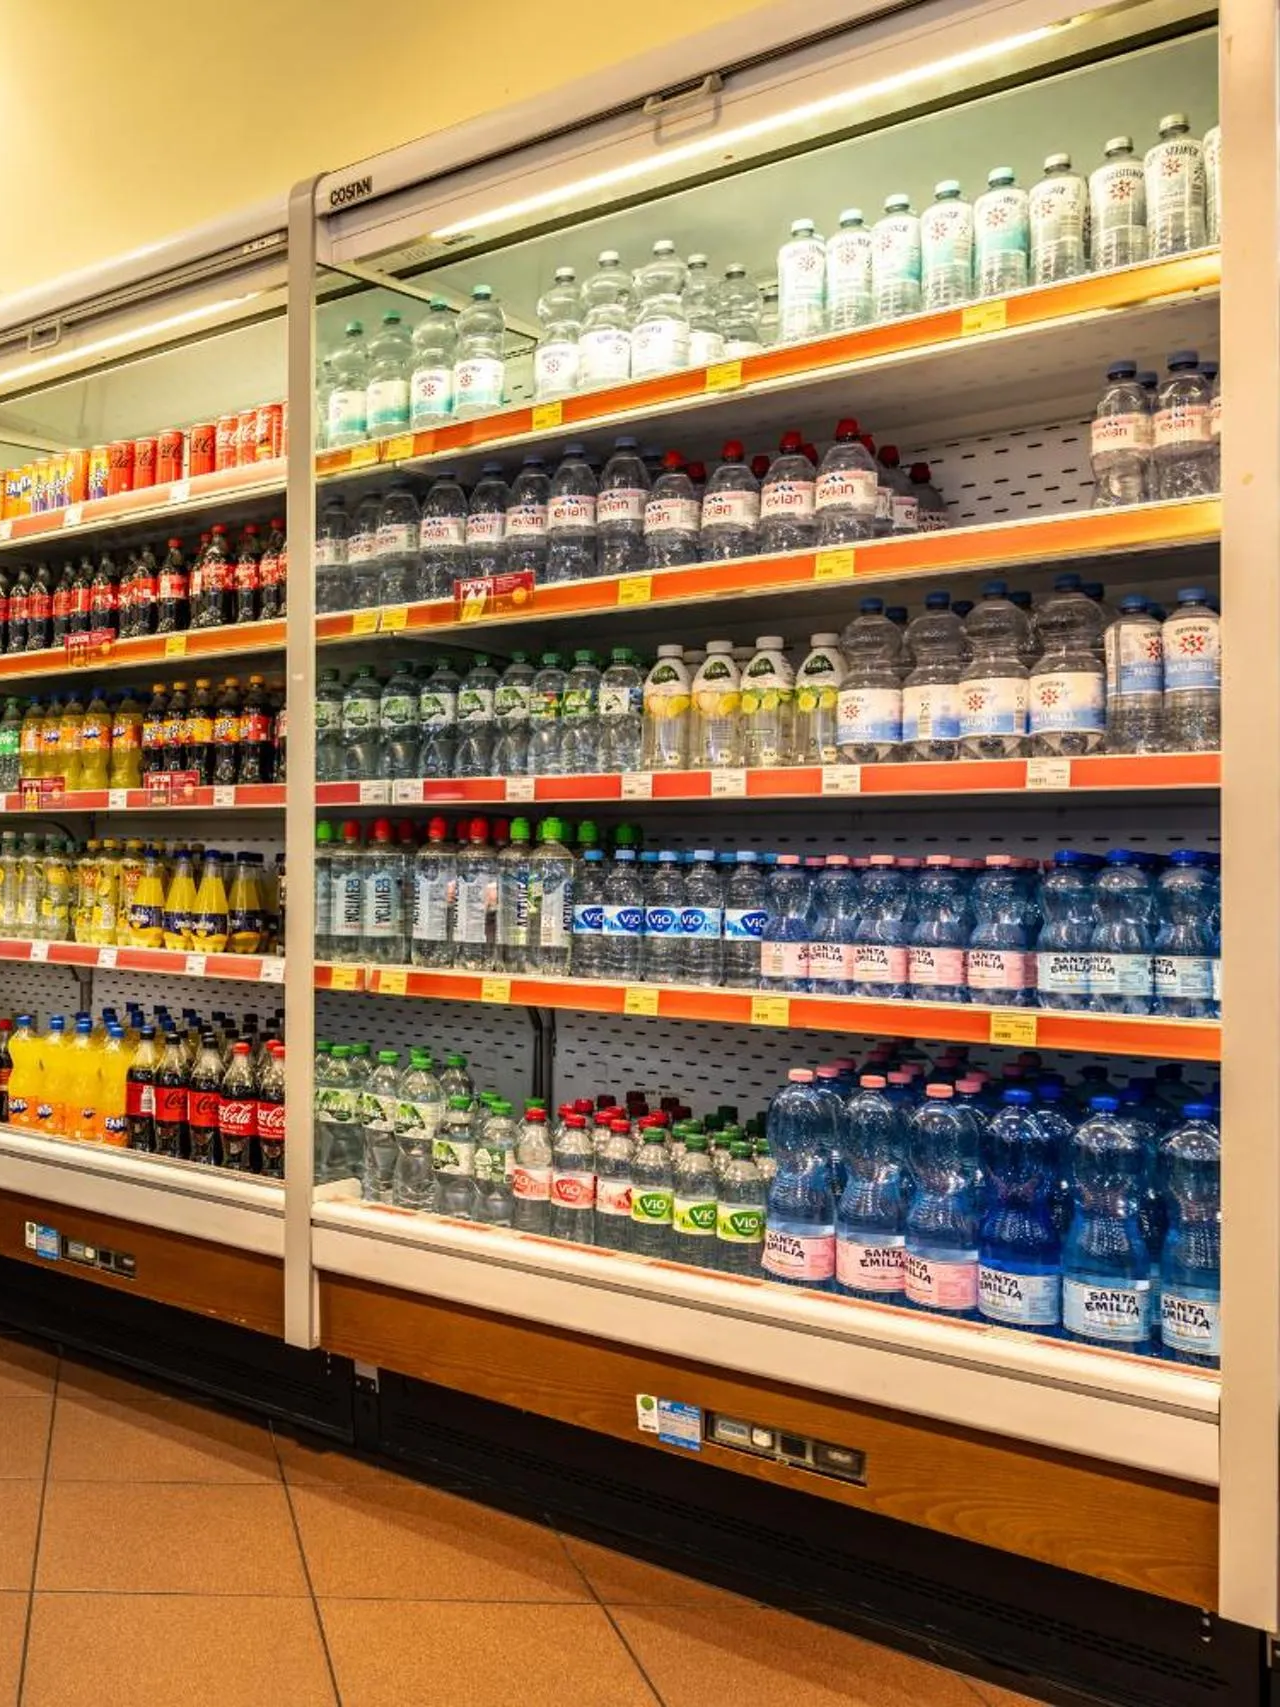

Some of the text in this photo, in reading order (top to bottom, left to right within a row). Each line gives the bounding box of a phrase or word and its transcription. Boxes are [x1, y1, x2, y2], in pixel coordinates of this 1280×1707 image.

[329, 175, 373, 207] COSTAN
[765, 491, 804, 508] evian
[818, 483, 855, 500] evian
[554, 505, 588, 518] evian
[646, 510, 671, 524] vian
[511, 514, 544, 527] evian
[768, 1232, 801, 1250] SANTA
[863, 1248, 904, 1260] SANTA
[859, 1257, 906, 1270] EMILIA
[980, 1270, 1019, 1290] SANTA
[1089, 1290, 1138, 1306] SANTA
[1084, 1301, 1141, 1317] EMILIA
[1163, 1298, 1206, 1318] SANTA
[1161, 1308, 1212, 1331] EMILIA
